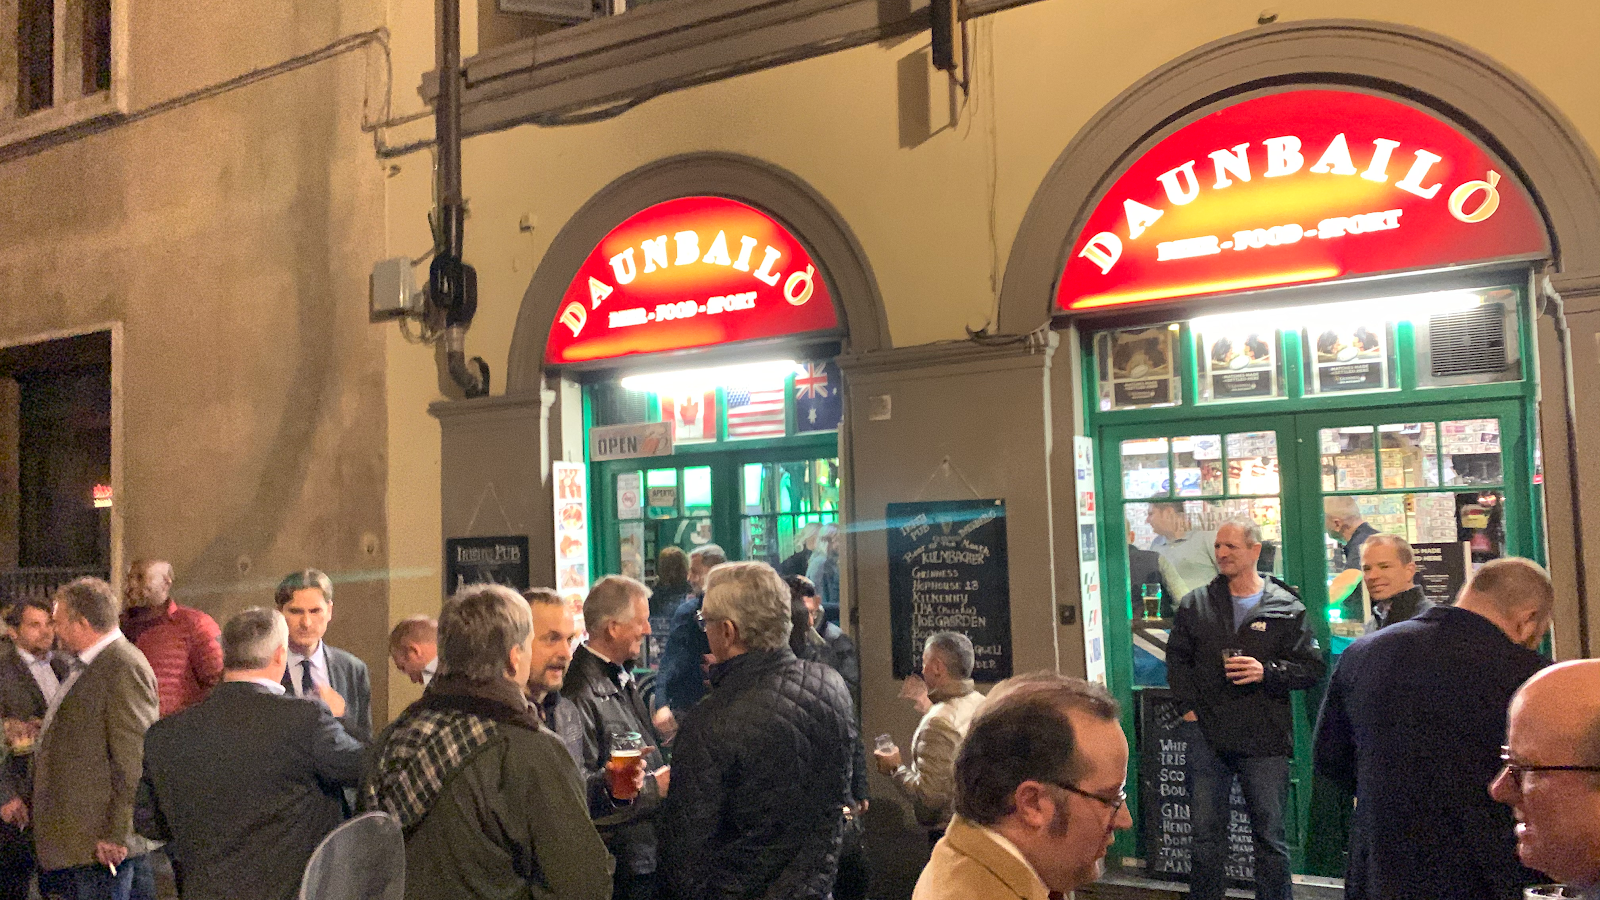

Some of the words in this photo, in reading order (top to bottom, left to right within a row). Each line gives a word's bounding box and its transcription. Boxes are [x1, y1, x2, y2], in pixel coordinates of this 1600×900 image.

[598, 436, 637, 455] OPEN
[1160, 754, 1186, 766] IRIS
[1161, 803, 1190, 819] GIN
